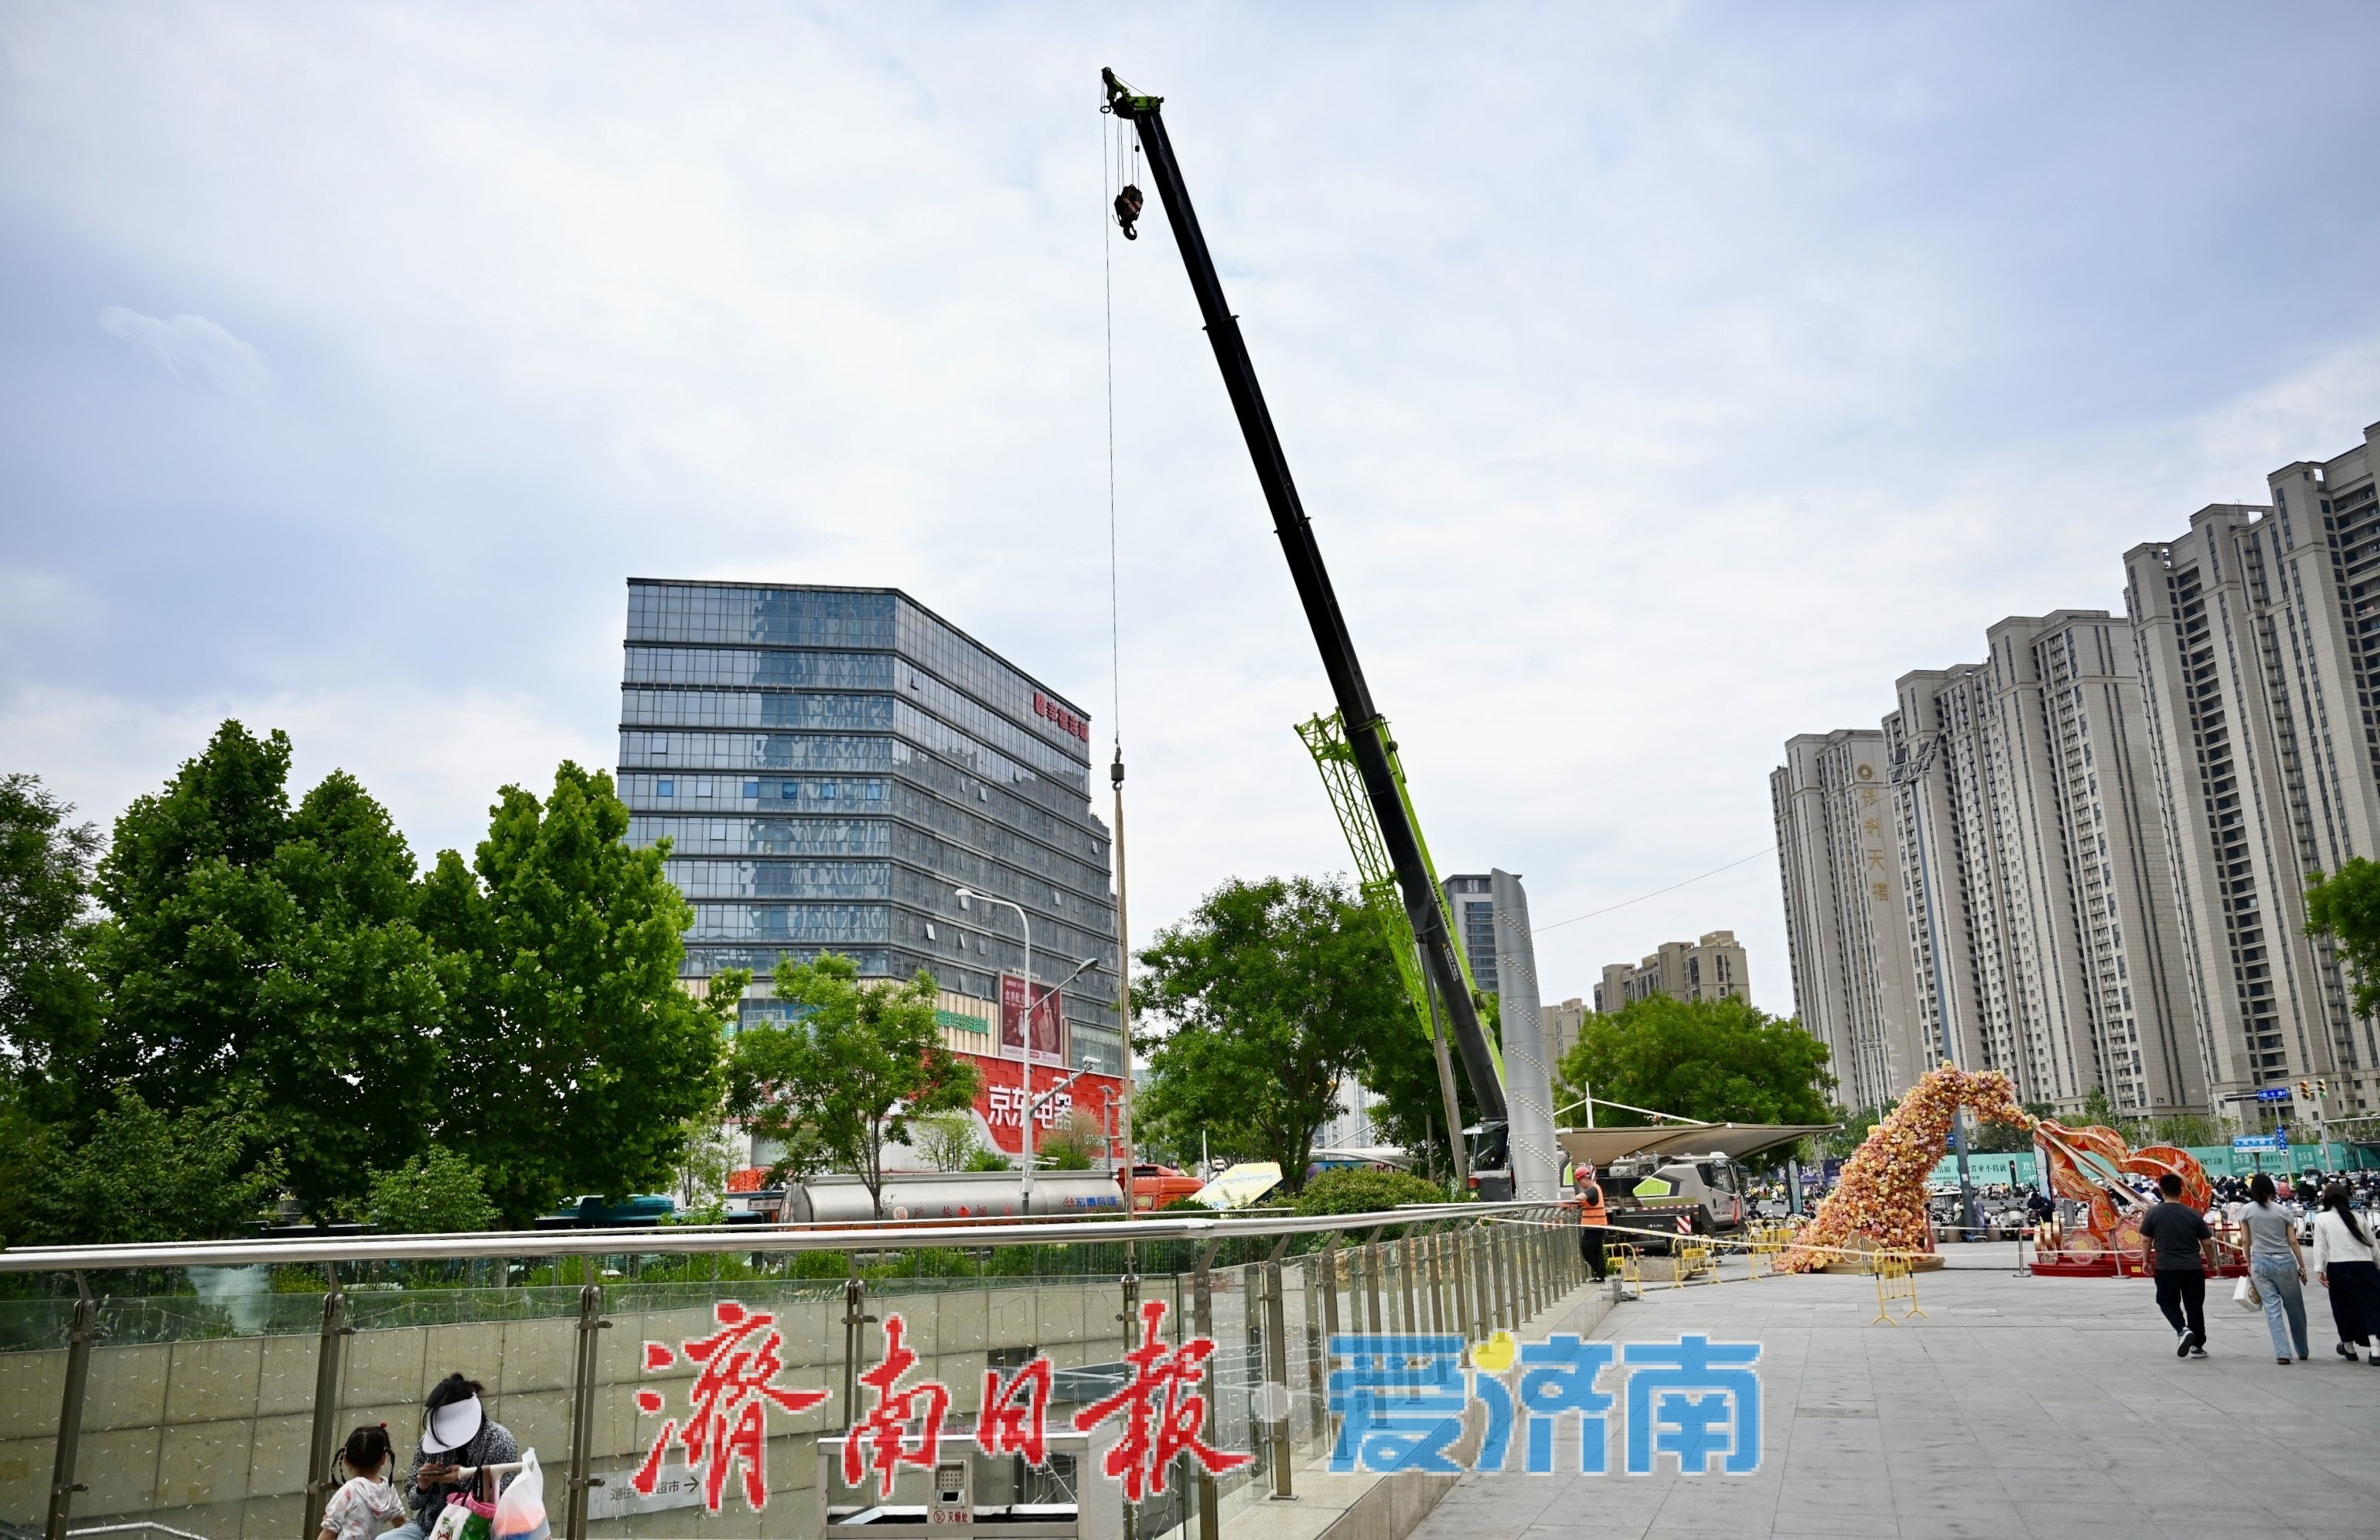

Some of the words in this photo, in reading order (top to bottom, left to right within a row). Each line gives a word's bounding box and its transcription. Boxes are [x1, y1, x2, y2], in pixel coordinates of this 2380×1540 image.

[1429, 874, 1451, 929] ZOOMLION
[987, 1084, 1072, 1130] 京东电器
[610, 1480, 680, 1501] 通往超市
[947, 1511, 968, 1523] 灭烟处
